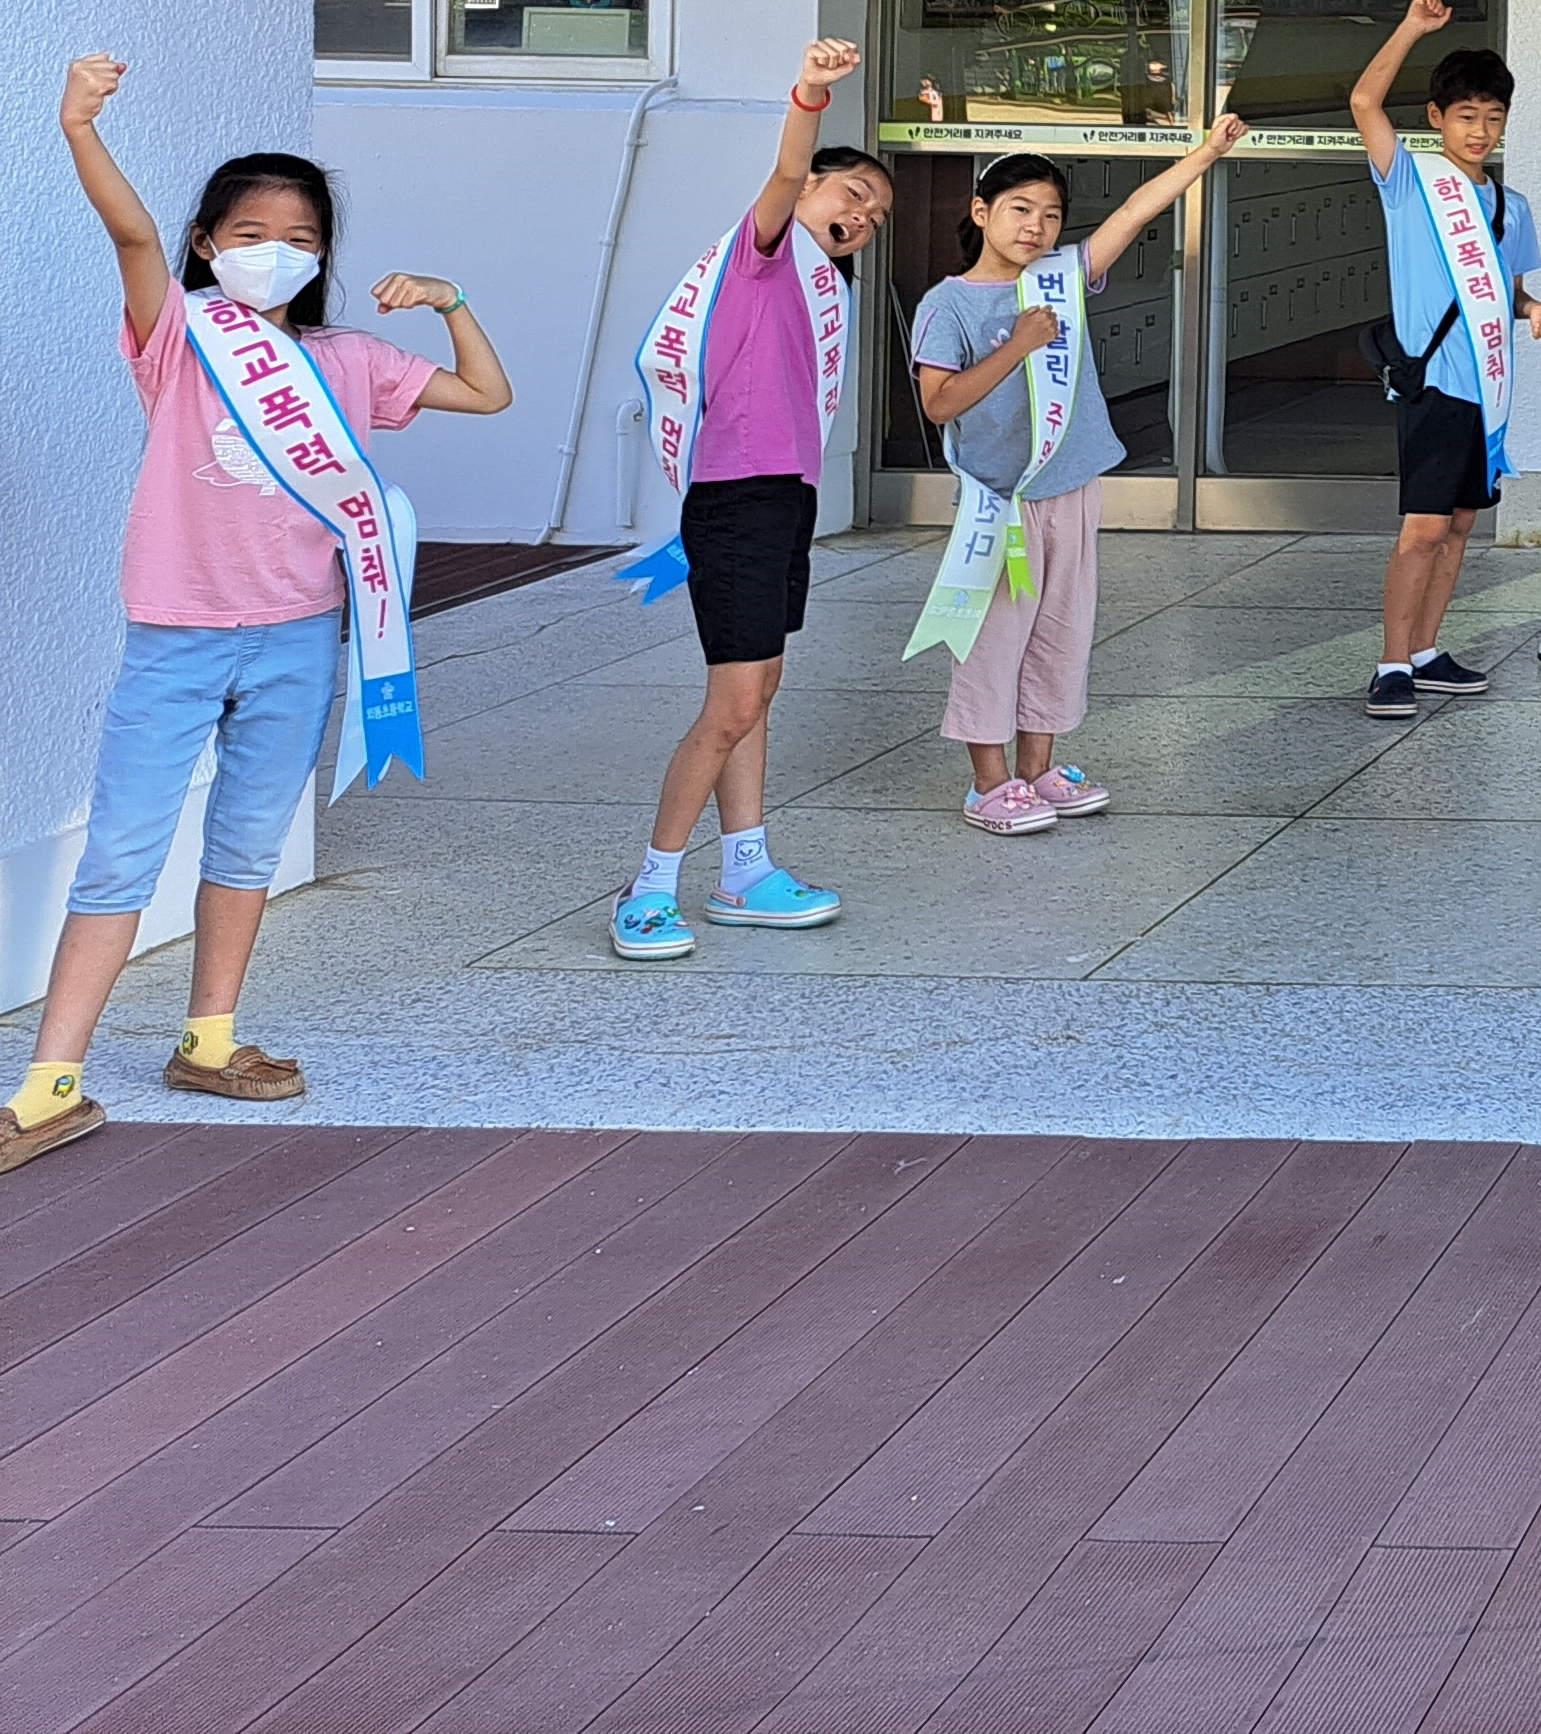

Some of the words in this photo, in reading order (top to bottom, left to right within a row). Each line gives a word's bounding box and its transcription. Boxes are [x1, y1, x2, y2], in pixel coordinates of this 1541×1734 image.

[923, 127, 972, 139] 안전거리를
[974, 128, 1023, 141] 지켜주세요
[1098, 131, 1147, 143] 안전거리를
[1149, 132, 1194, 144] 지켜주세요
[1266, 134, 1315, 146] 안전거리를
[1317, 134, 1364, 147] 지켜주세요
[1409, 137, 1444, 149] 안전거
[1037, 271, 1067, 304] 번
[1433, 175, 1498, 304] 학교폭력
[1480, 317, 1505, 408] 멈춰!
[654, 240, 724, 405] 학교폭력
[201, 298, 347, 477] 학교폭력
[336, 490, 389, 640] 멈춰!
